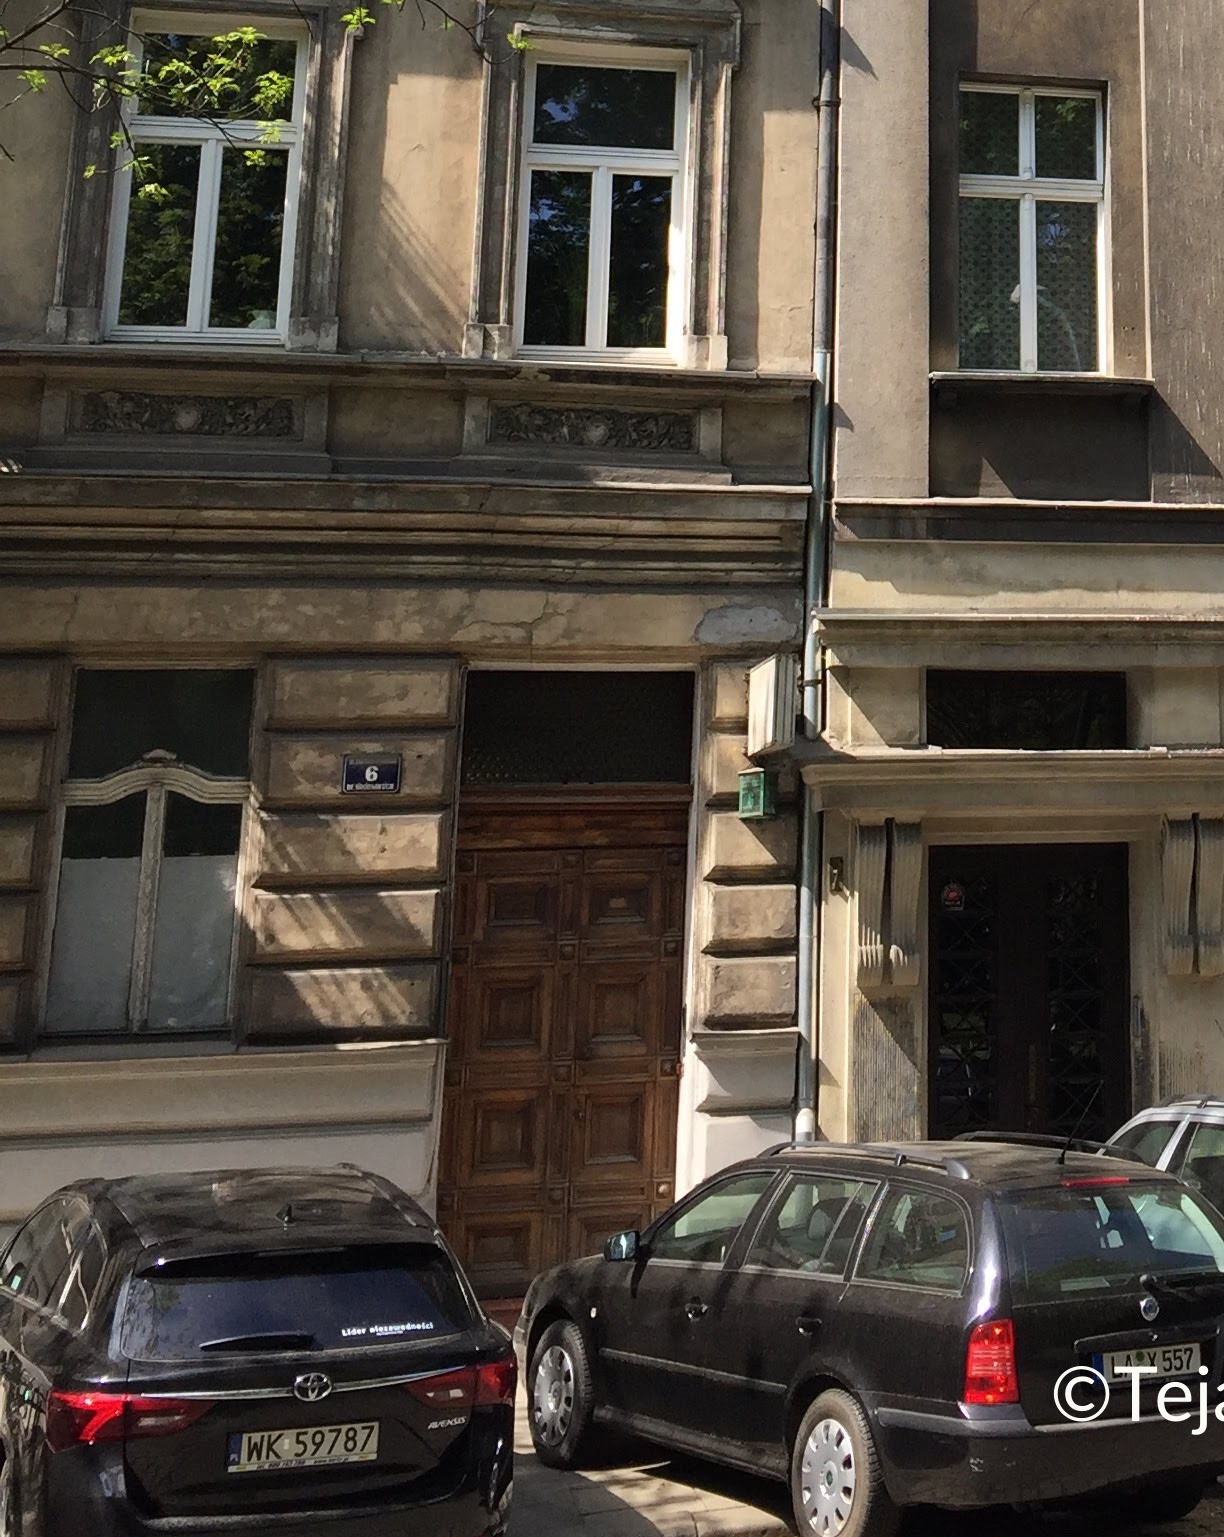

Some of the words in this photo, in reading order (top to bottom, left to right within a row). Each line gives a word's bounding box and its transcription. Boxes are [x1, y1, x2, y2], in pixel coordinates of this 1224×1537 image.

[365, 765, 379, 782] 6
[1162, 1347, 1193, 1372] 557
[247, 1433, 284, 1462] WK
[294, 1425, 375, 1458] 59787
